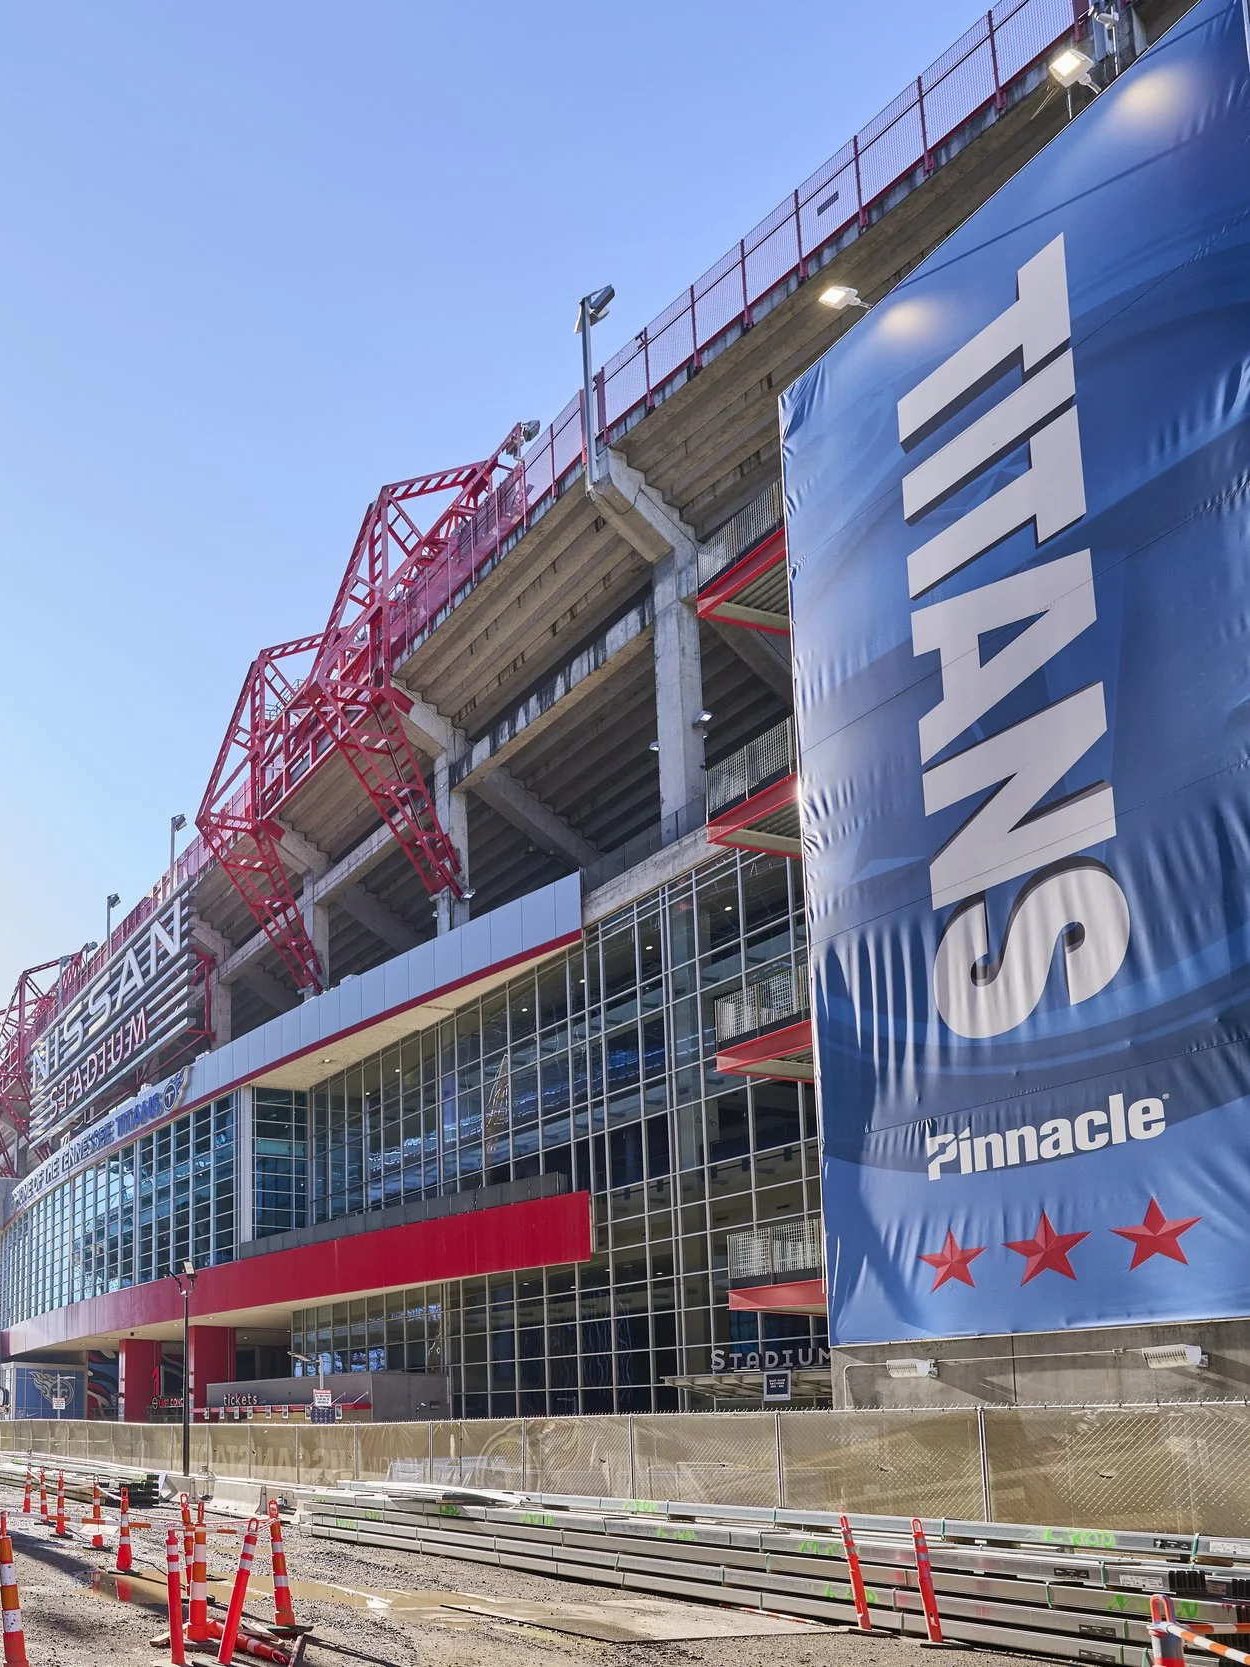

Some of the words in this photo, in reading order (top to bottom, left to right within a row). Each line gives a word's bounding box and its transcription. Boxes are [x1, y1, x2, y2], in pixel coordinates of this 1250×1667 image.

[897, 231, 1131, 1039] TITANS
[30, 897, 182, 1092] NISSAN
[49, 1005, 149, 1119] STADIUM
[61, 1120, 115, 1173] TENNESSEE
[115, 1091, 163, 1138] TITANS
[927, 1092, 1167, 1181] Pinnacle
[223, 1393, 258, 1406] tickets
[711, 1347, 831, 1371] STADIUM
